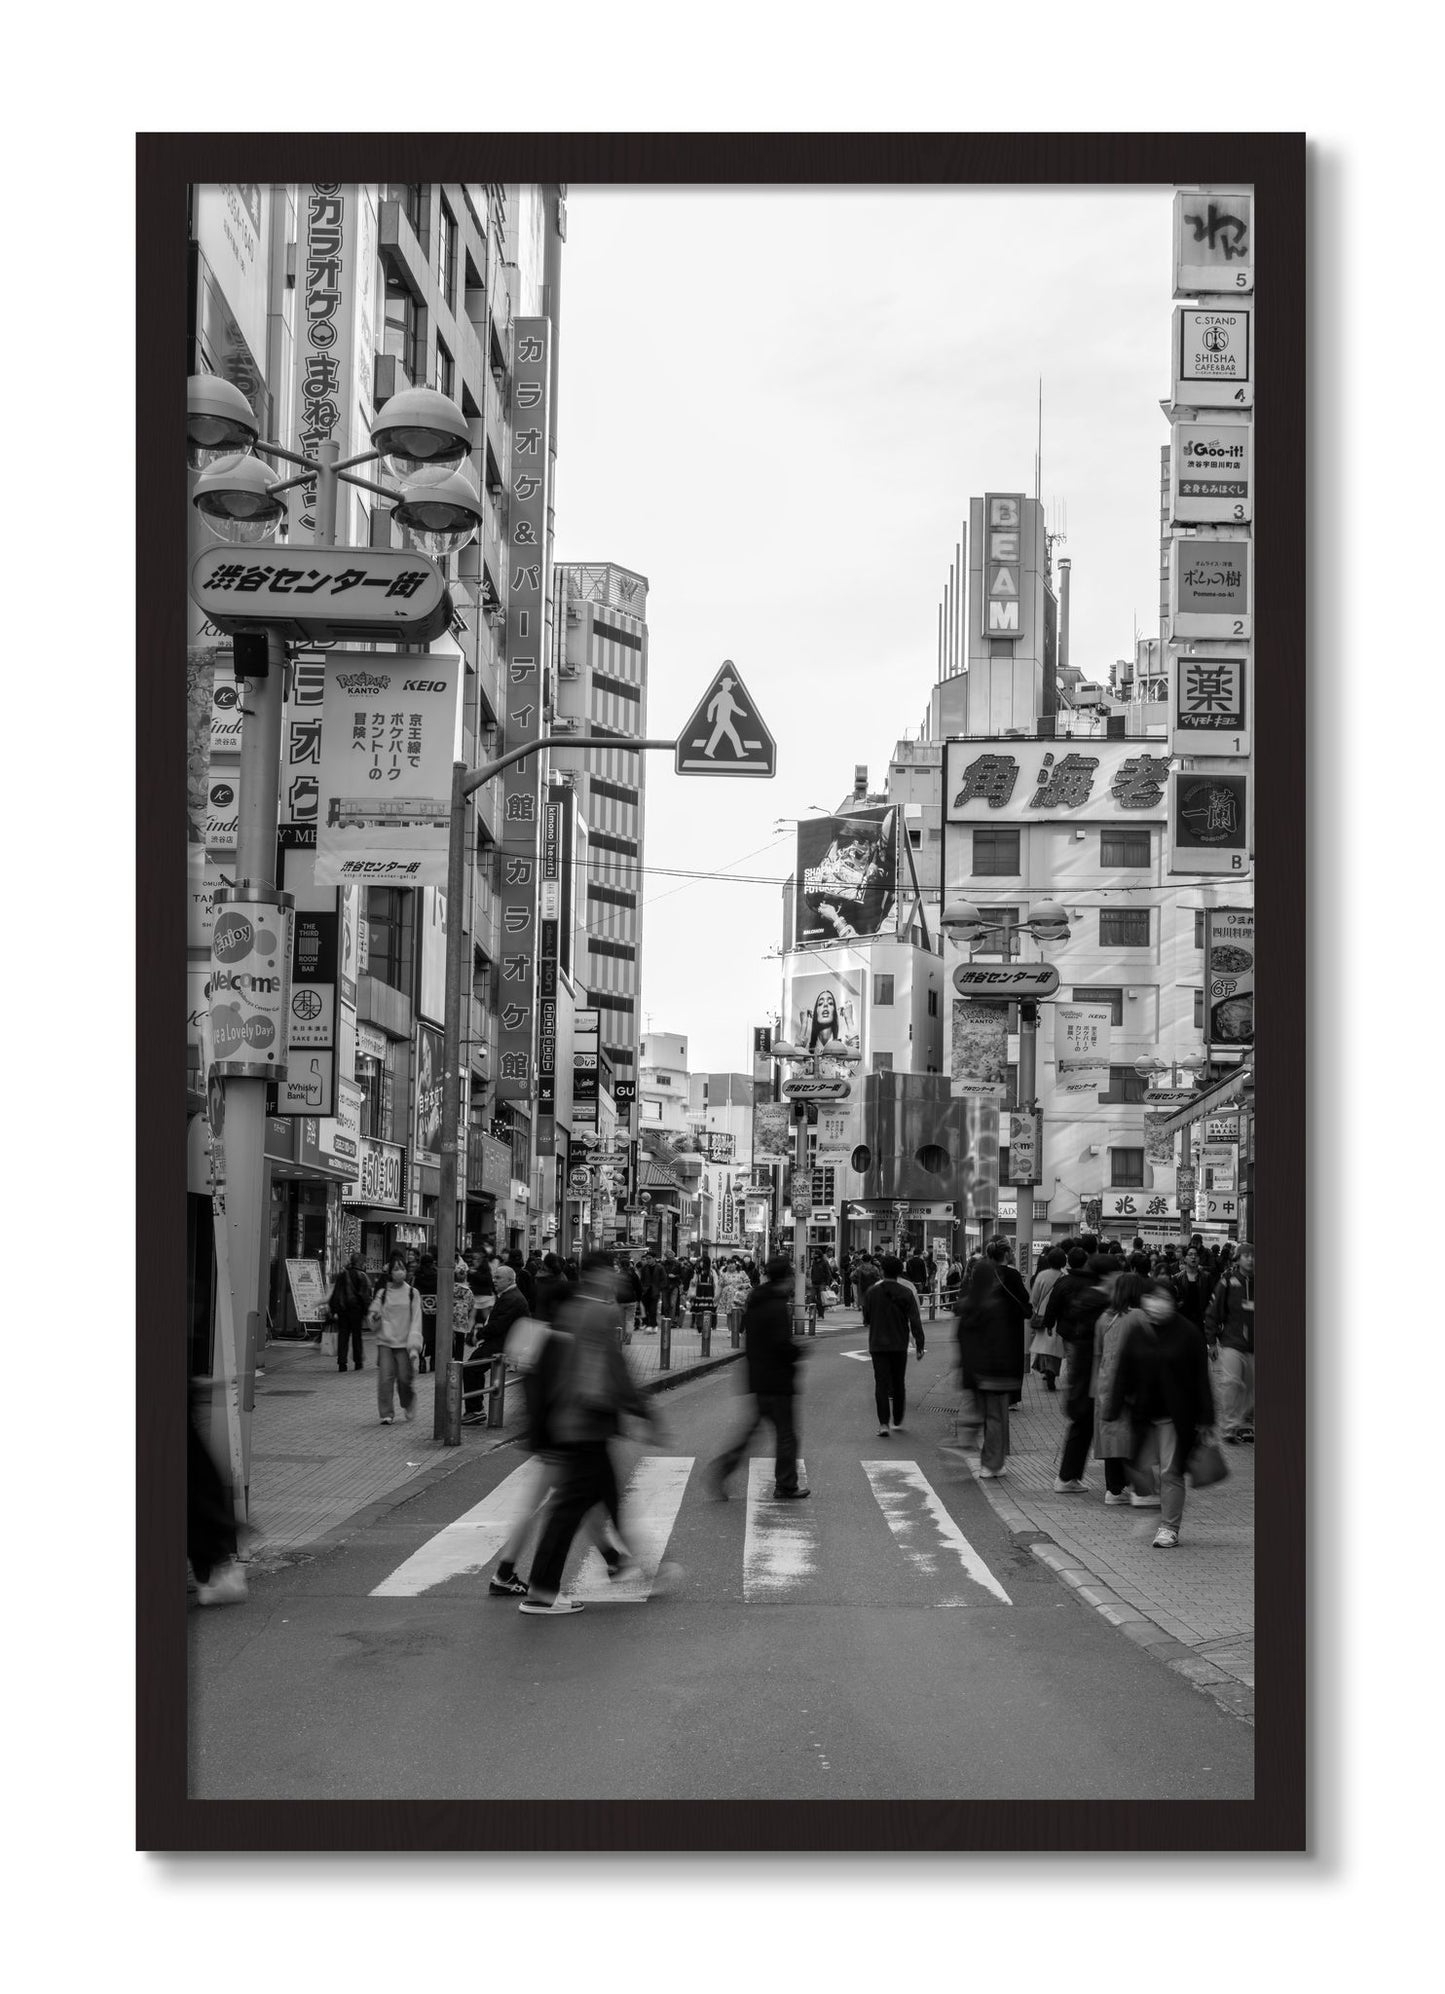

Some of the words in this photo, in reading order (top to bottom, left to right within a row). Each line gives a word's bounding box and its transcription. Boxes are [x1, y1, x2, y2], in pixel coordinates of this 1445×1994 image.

[306, 196, 344, 322] カラオケ
[1236, 273, 1247, 287] 5
[1195, 316, 1237, 325] C.STAND
[1195, 353, 1236, 363] SHISHA
[1193, 442, 1244, 457] Goo-it!
[1183, 484, 1245, 494] 全身もみほぐし
[1233, 504, 1245, 520] 3
[990, 498, 1019, 629] BEAM
[202, 563, 430, 599] 渋谷センター街
[1233, 620, 1244, 635] 2
[403, 680, 447, 692] KEIO
[1187, 665, 1233, 712] 薬
[352, 712, 367, 751] 冒険へ
[369, 712, 385, 780] カントーの
[407, 713, 423, 768] 京王線で
[1232, 737, 1240, 752] 1
[953, 752, 1176, 808] 角海老
[1181, 788, 1237, 832] 一蘭
[341, 860, 421, 872] 渋谷センター街
[1231, 855, 1241, 869] B
[214, 924, 252, 955] Enjoy
[1212, 927, 1252, 938] 四川料理
[210, 969, 281, 993] Welcome
[960, 972, 1053, 984] 渋谷センター街
[1211, 980, 1237, 998] 6F
[287, 1083, 318, 1093] Whisky
[616, 1086, 634, 1096] GU
[266, 1102, 276, 1111] 1F
[1115, 1195, 1169, 1214] 兆楽
